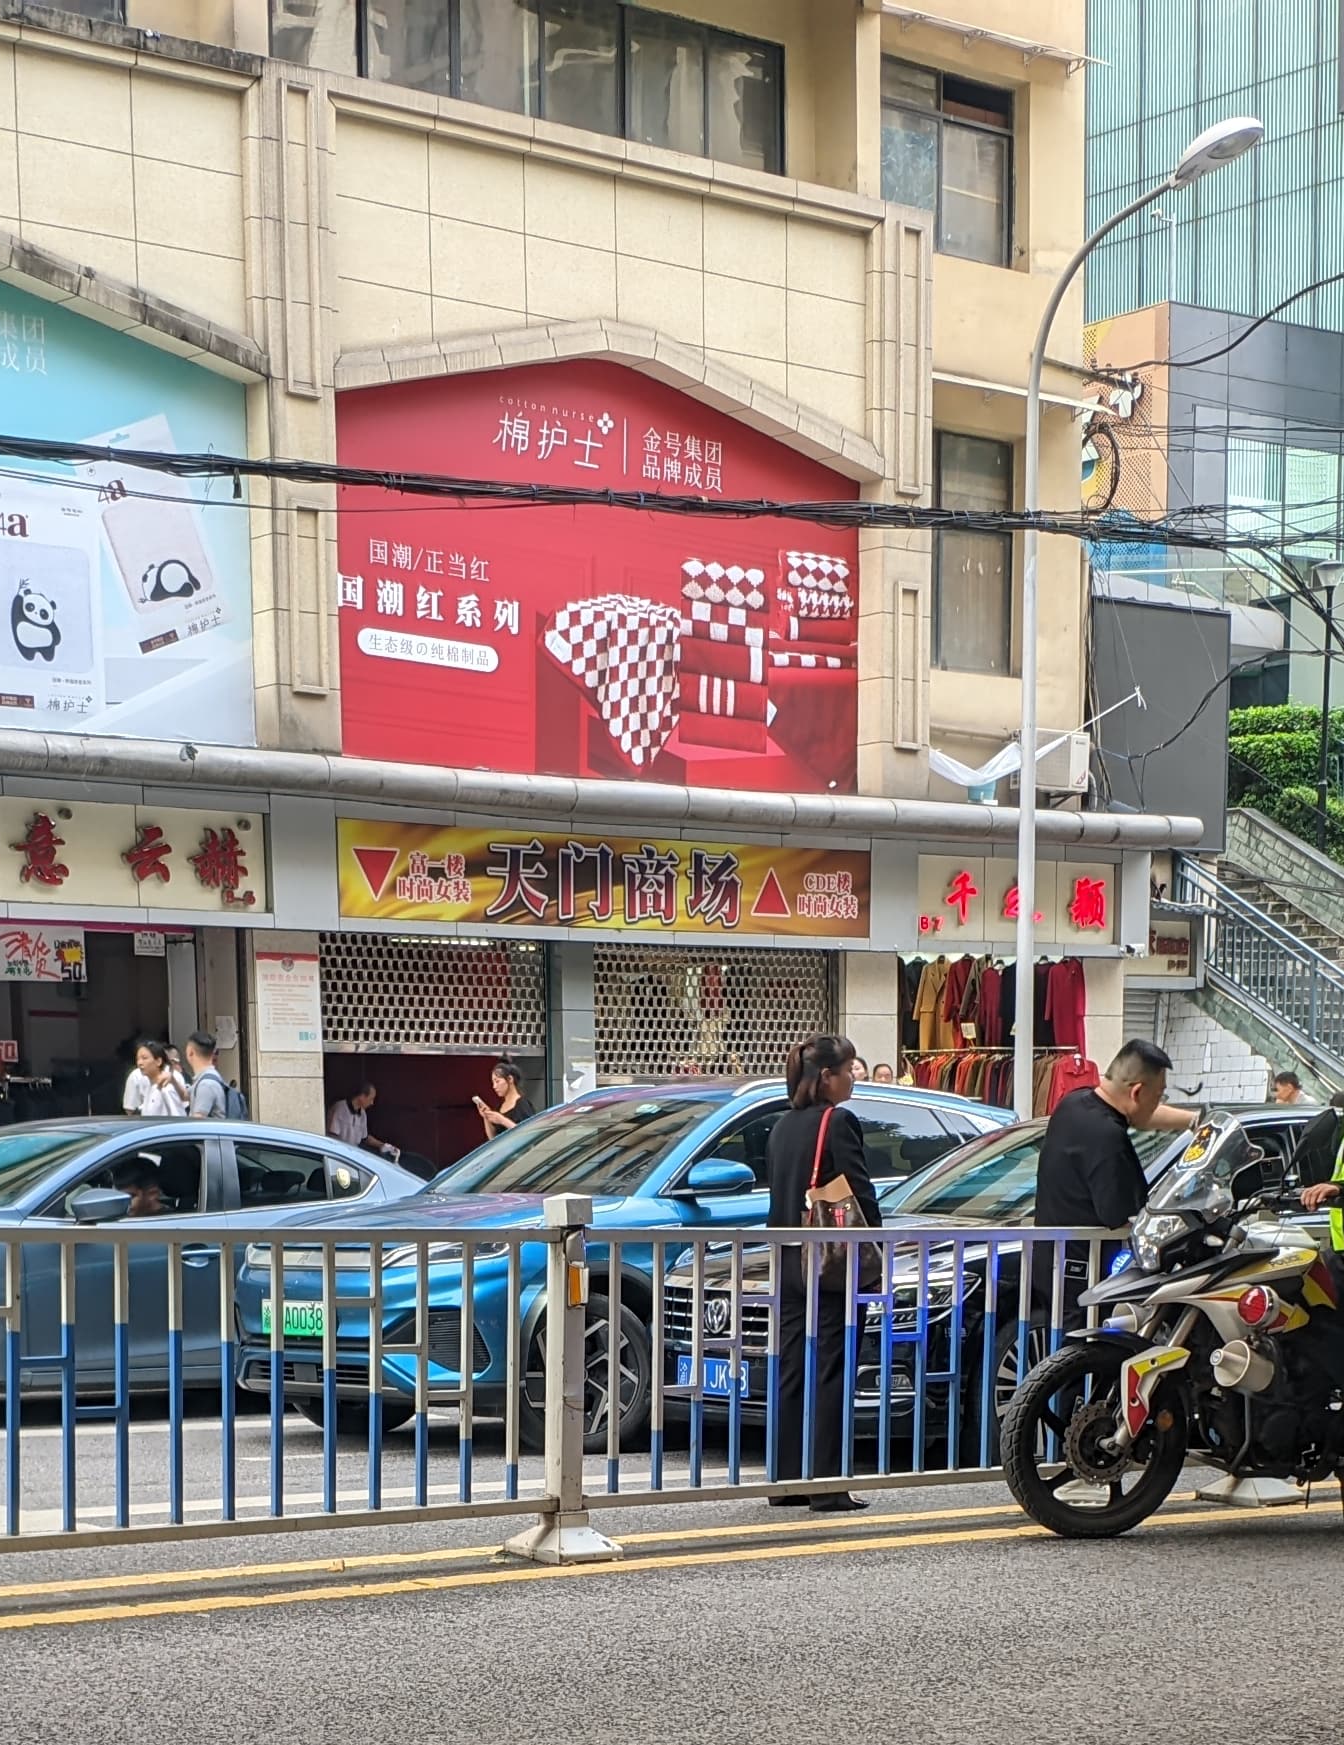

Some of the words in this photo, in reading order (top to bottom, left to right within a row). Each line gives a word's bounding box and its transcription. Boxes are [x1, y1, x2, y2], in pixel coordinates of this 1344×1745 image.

[498, 394, 547, 414] cotton
[551, 405, 595, 424] nurse
[492, 411, 604, 470] 棉护士
[641, 427, 724, 467] 金号集团
[641, 453, 724, 493] 品牌成员
[368, 537, 491, 583] 国潮/正当红
[337, 571, 521, 636] 国潮红系列
[368, 634, 491, 669] 生态级の纯棉制品
[47, 698, 89, 714] 棉护士
[121, 825, 248, 893] 云赫
[409, 851, 464, 877] 富一楼
[397, 878, 472, 904] 时尚女装
[486, 838, 742, 928] 天门商场
[803, 872, 852, 895] CDE楼
[796, 894, 859, 920] 时尚女装
